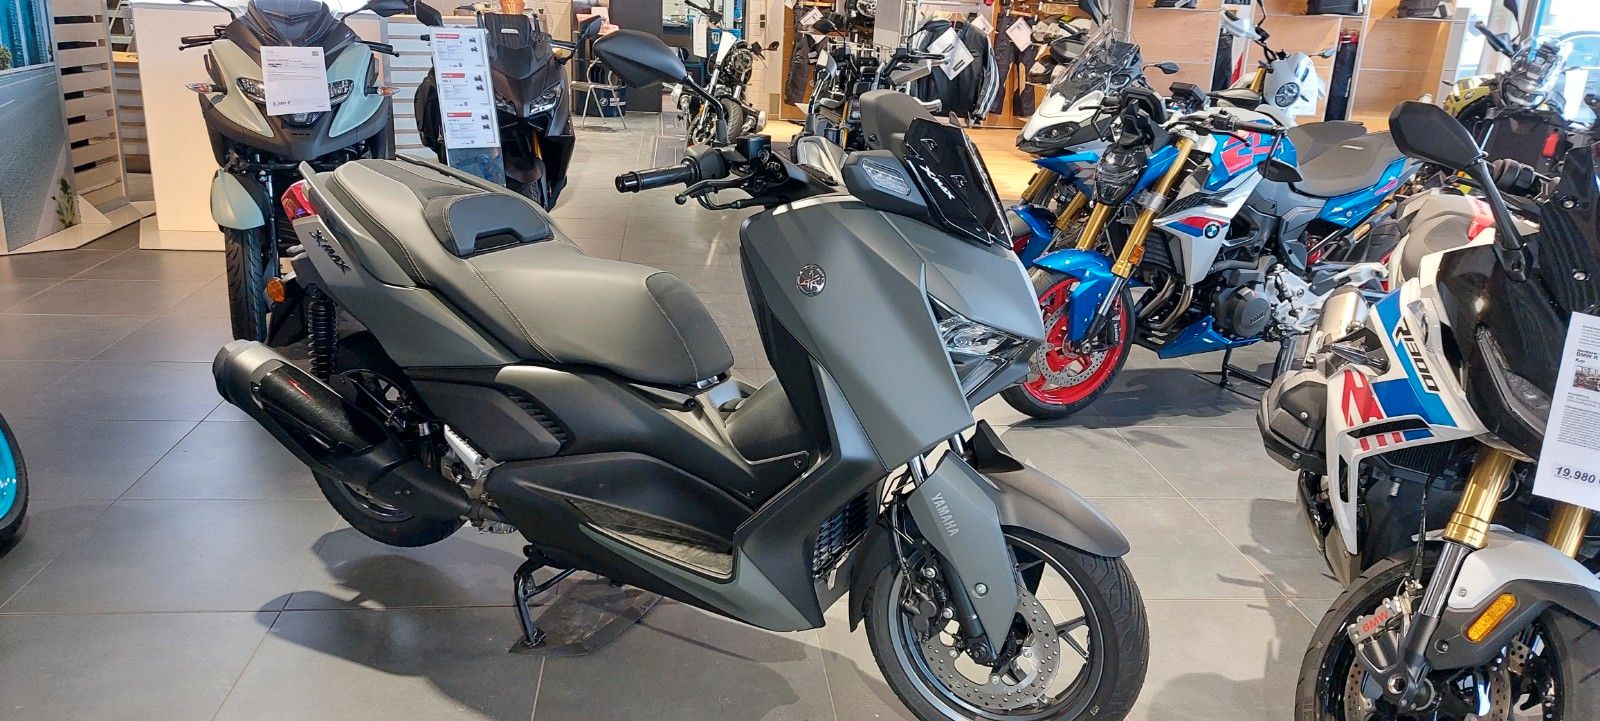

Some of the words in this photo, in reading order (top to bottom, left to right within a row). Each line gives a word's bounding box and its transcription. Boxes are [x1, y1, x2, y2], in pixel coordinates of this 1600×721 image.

[1556, 466, 1596, 484] 19.980
[932, 492, 960, 537] YAMAHA
[1362, 610, 1388, 632] BMW
